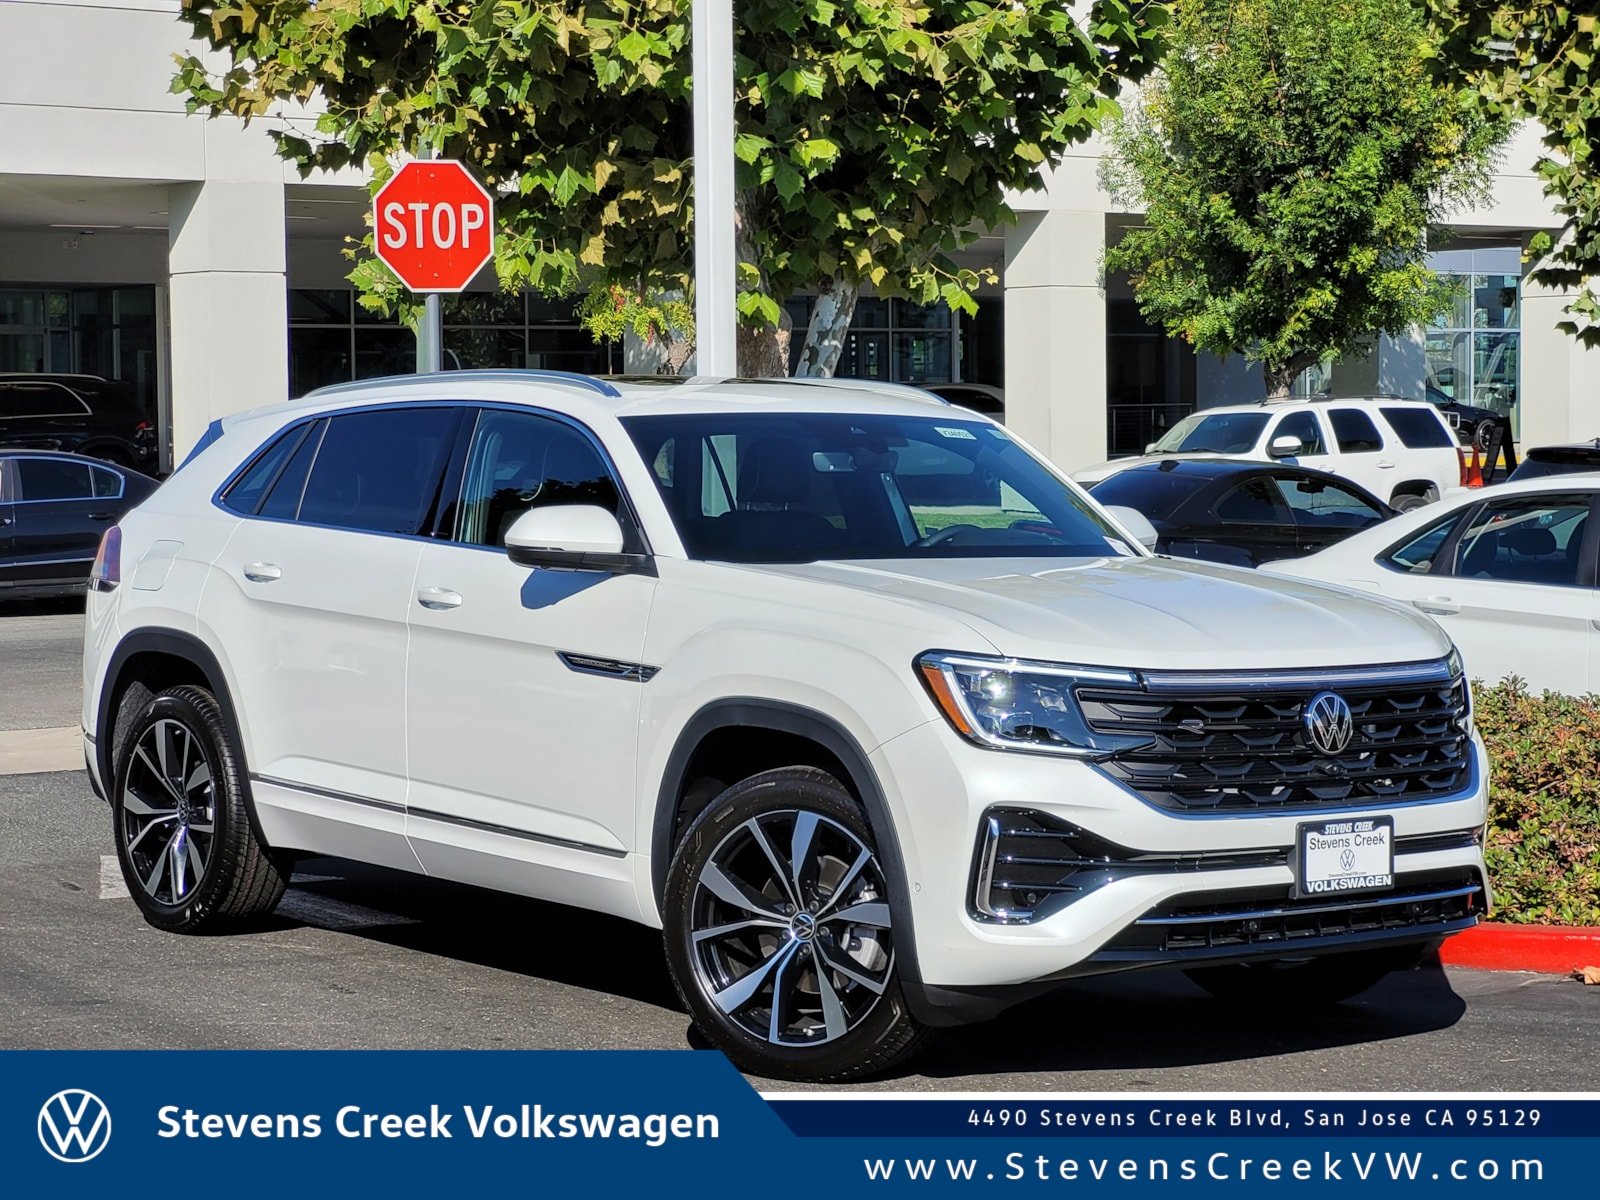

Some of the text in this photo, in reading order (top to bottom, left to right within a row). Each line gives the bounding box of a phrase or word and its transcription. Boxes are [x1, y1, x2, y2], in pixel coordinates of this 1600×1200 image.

[384, 202, 484, 249] STOP
[1324, 820, 1374, 835] STEVENS CREEK
[1309, 832, 1385, 850] Stevens Creek
[1306, 874, 1392, 893] VOLKSWAGEN
